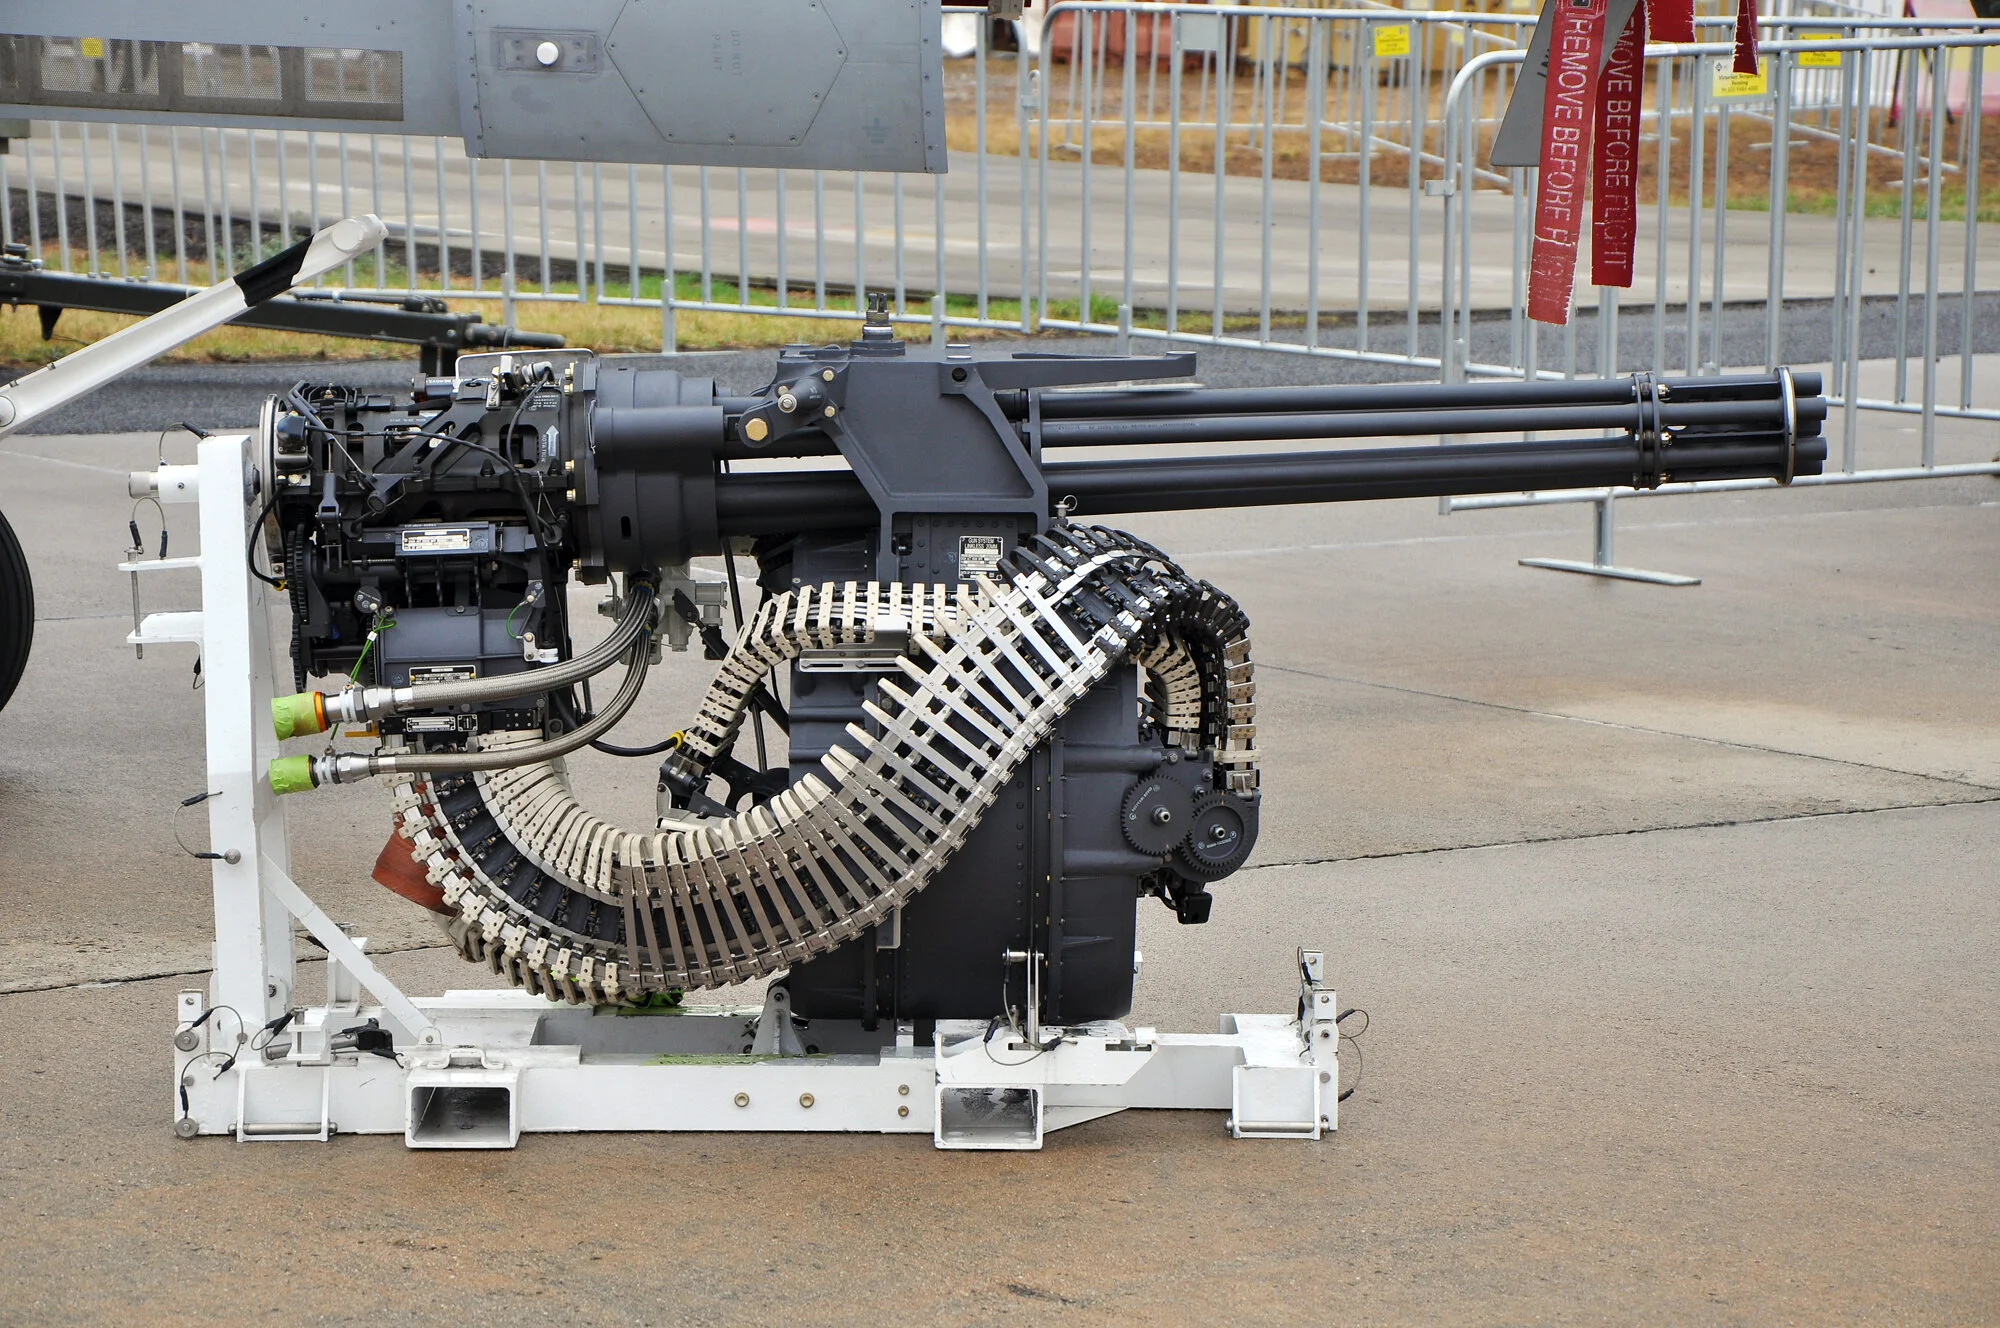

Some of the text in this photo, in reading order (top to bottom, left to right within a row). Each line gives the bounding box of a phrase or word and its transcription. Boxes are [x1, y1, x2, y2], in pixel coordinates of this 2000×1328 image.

[711, 33, 722, 71] PAINT
[731, 30, 742, 77] DO NOT
[1554, 19, 1592, 120] REMOVE
[1607, 17, 1634, 93] MOVE
[1545, 126, 1580, 221] BEFORE
[1605, 100, 1632, 188] BEFORE
